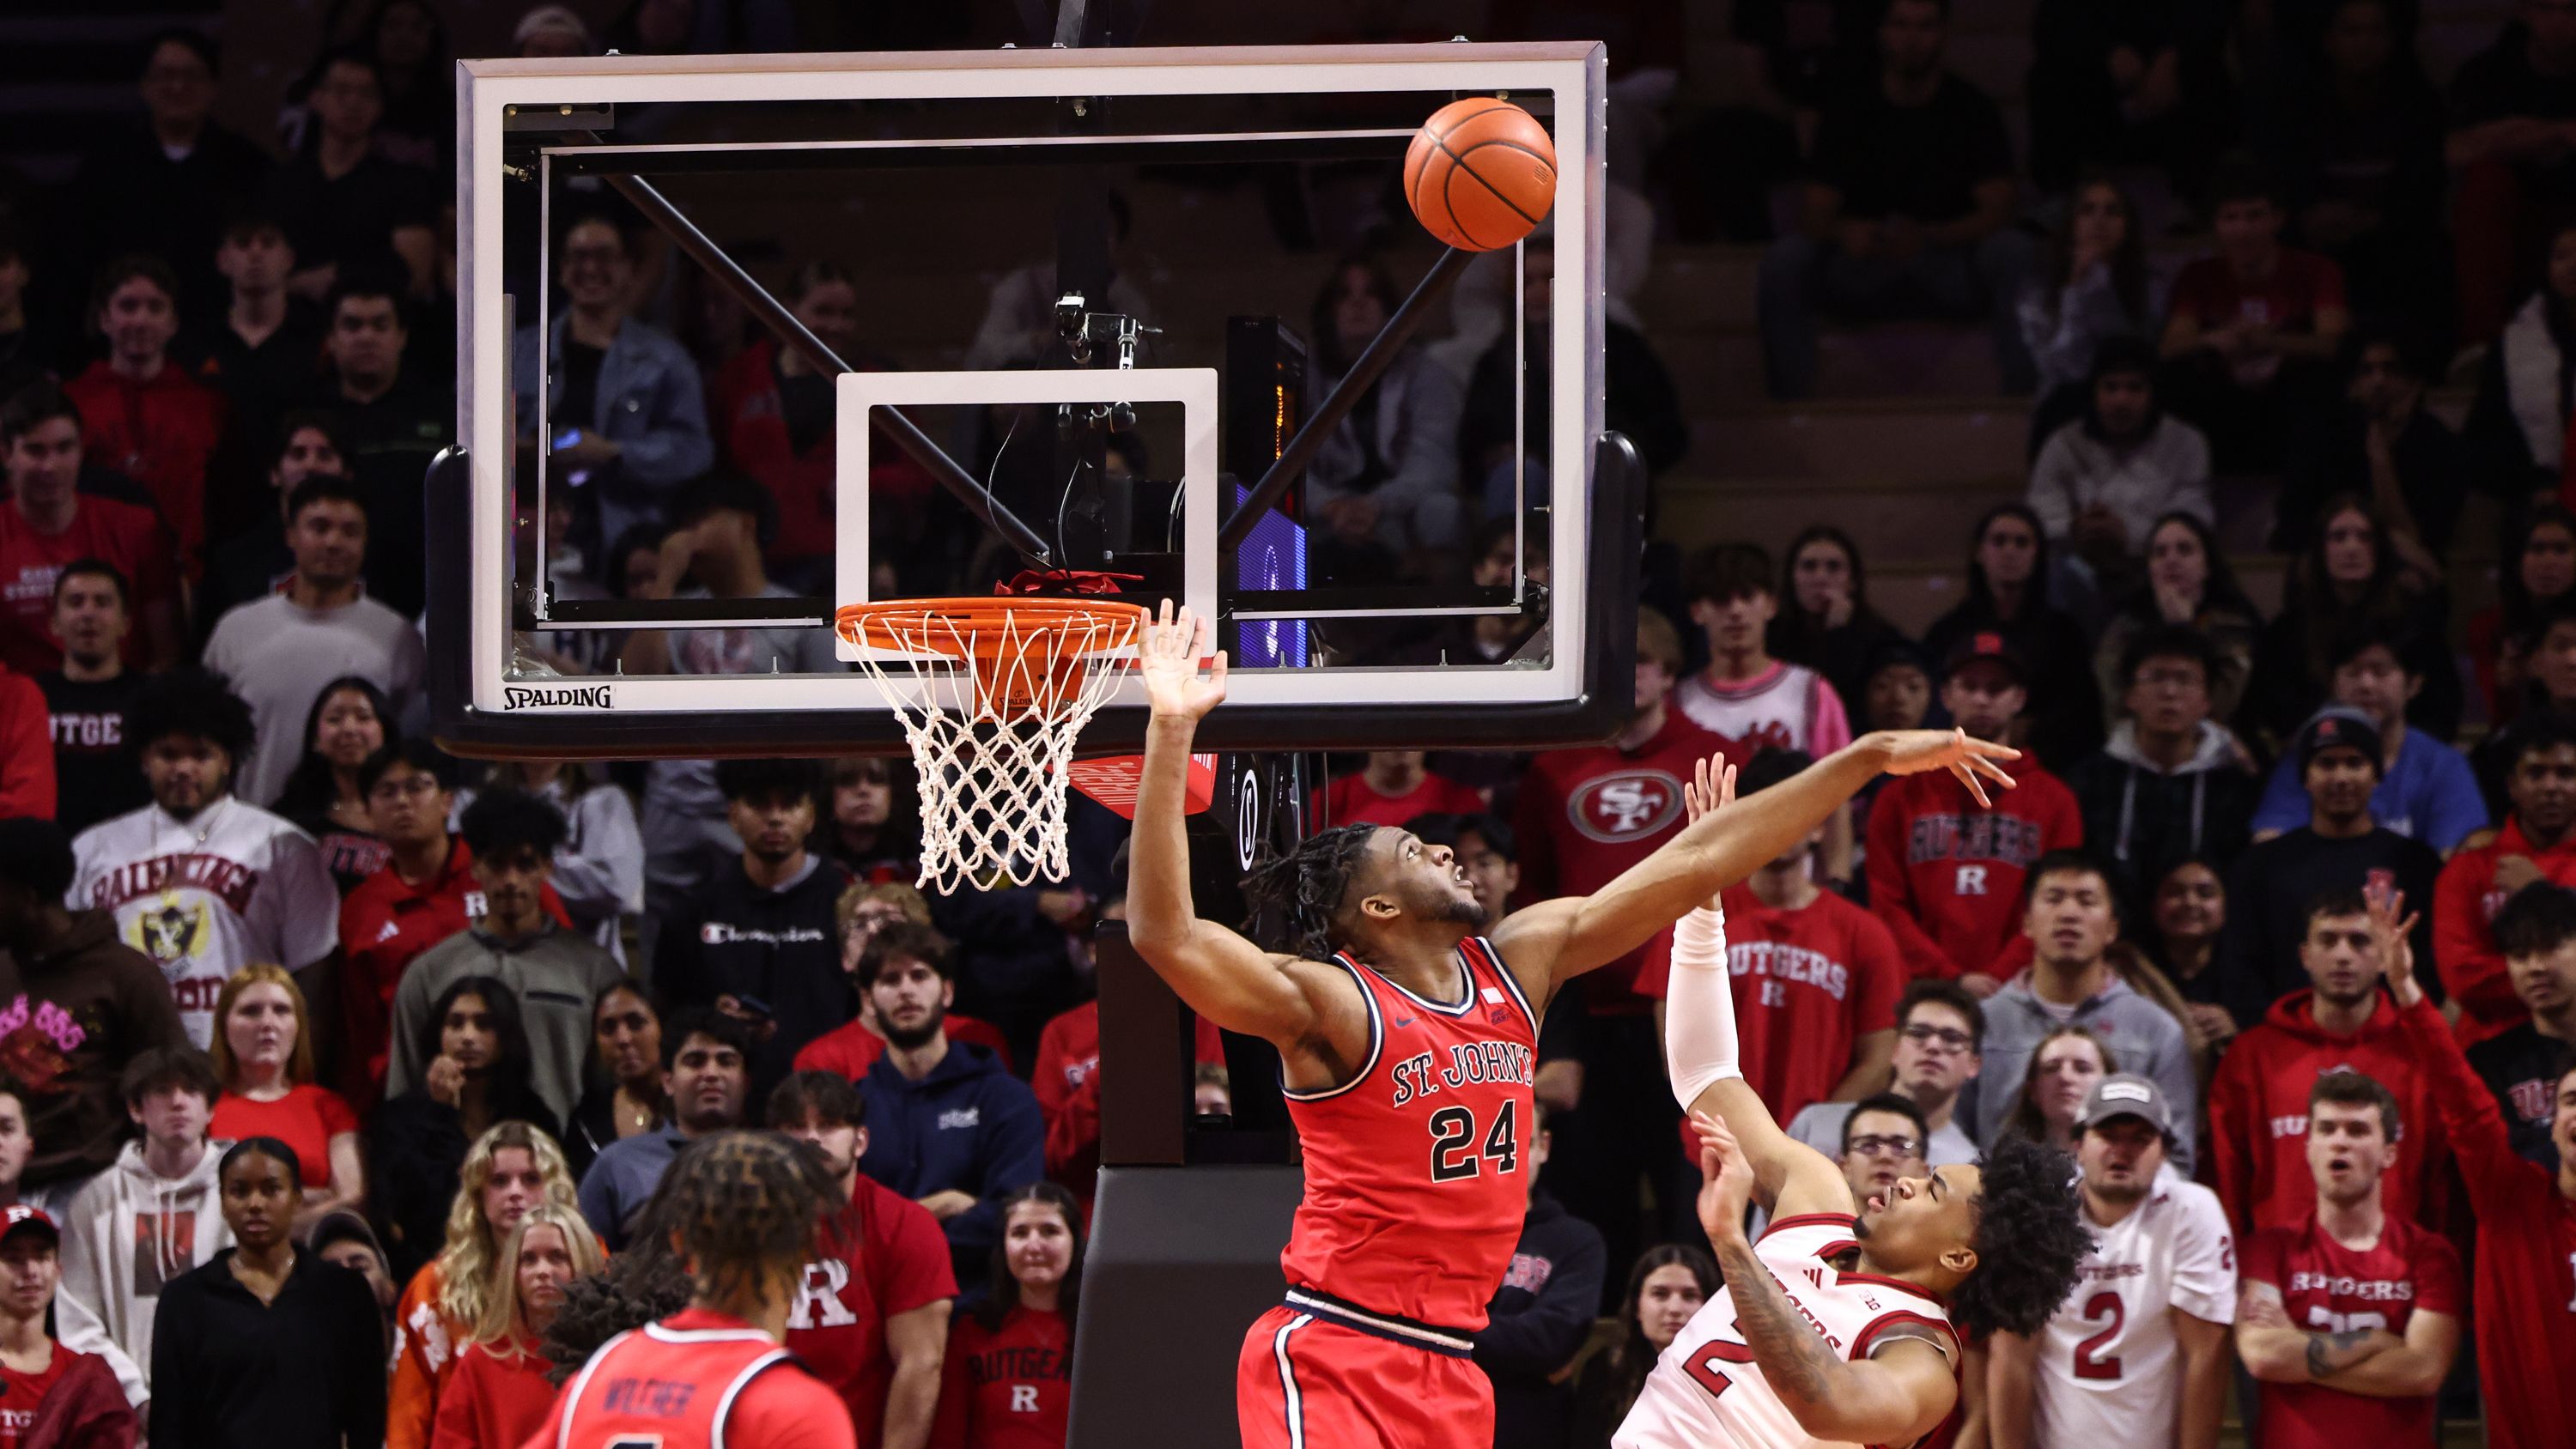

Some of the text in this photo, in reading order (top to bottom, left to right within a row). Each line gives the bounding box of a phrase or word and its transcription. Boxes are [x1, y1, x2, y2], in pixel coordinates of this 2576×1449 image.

[504, 685, 611, 711] SPALDING
[999, 696, 1033, 707] SALDIN
[1954, 864, 1988, 895] R
[700, 922, 824, 949] Champion
[1725, 940, 1848, 1001] UTGERS
[1760, 979, 1786, 1008] R
[1392, 1040, 1534, 1108] ST. JOHN'S
[1429, 1099, 1517, 1184] 24
[786, 1258, 857, 1330] R
[2075, 1292, 2123, 1379] 2
[967, 1347, 1072, 1385] RUTGE
[1011, 1385, 1040, 1412] R
